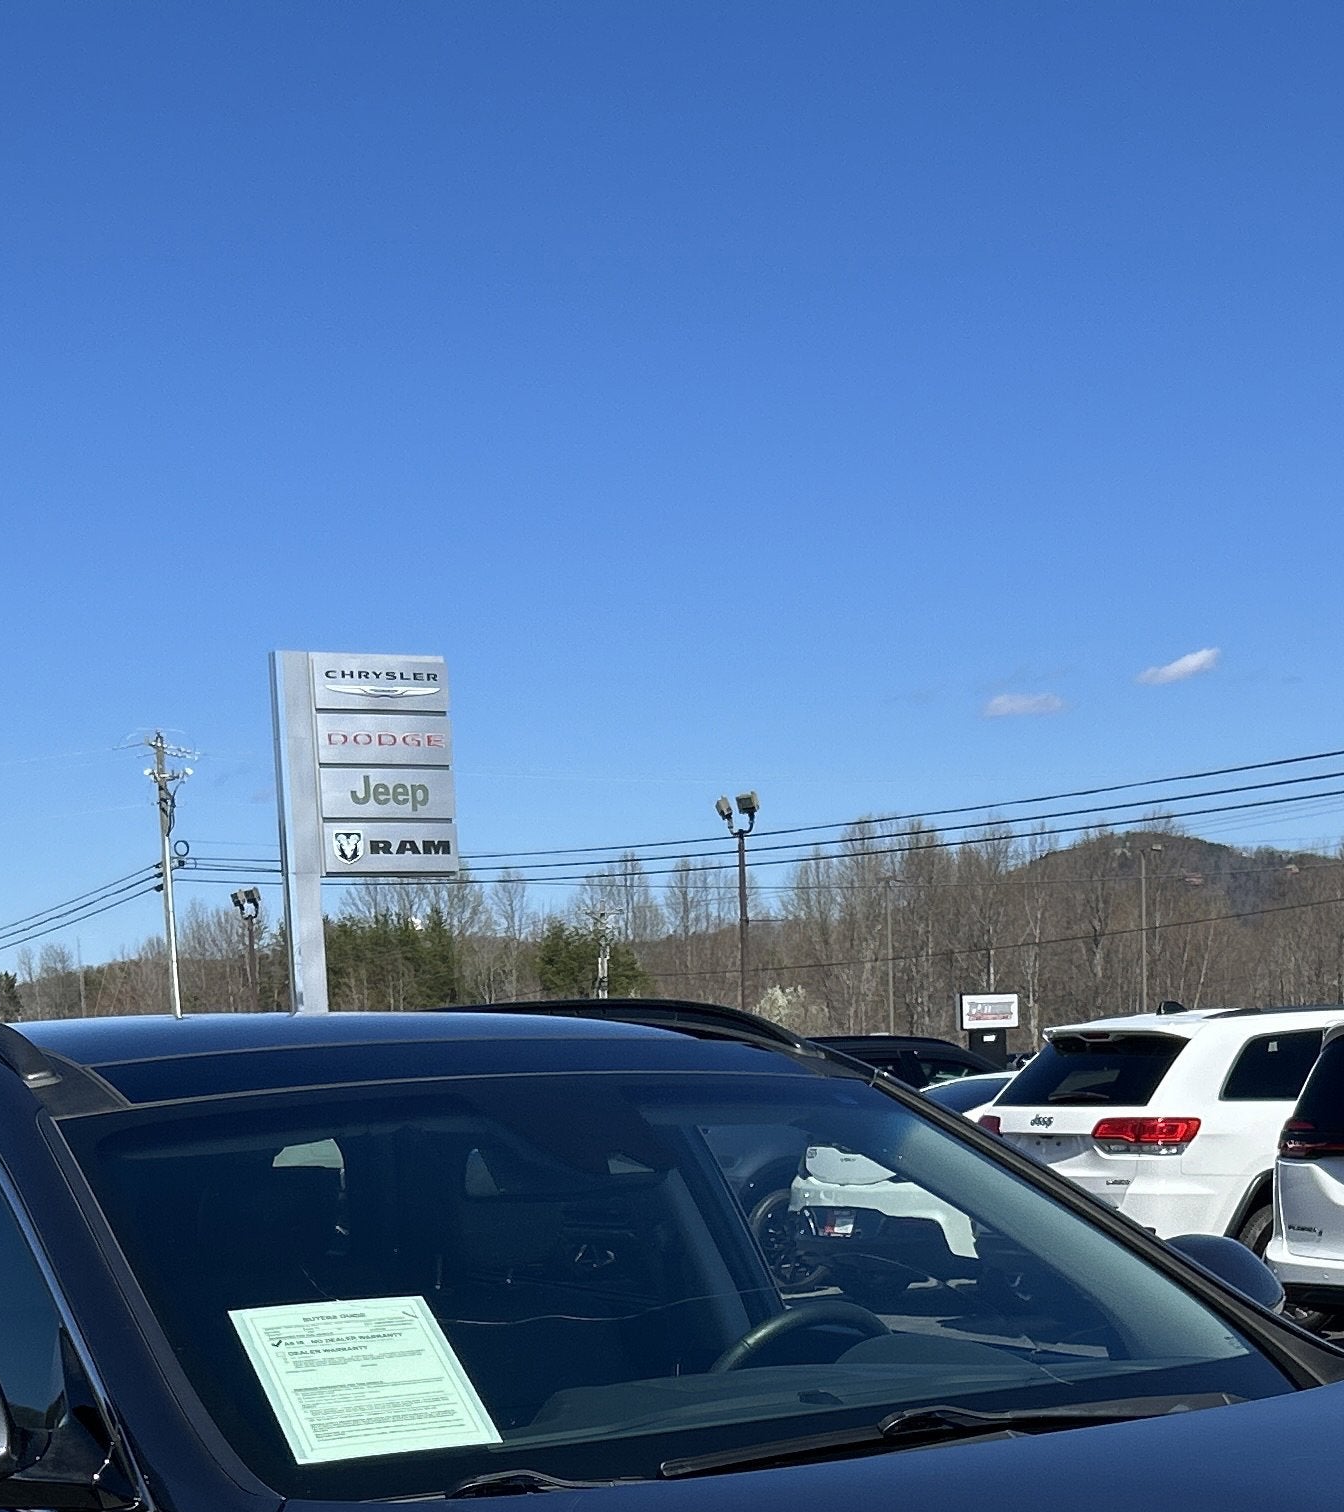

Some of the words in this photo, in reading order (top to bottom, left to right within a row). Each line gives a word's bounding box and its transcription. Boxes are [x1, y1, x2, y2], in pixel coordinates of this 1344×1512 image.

[325, 670, 438, 682] CHRYSLER
[327, 732, 445, 748] DODGE
[350, 775, 429, 811] Jeep
[369, 839, 451, 855] RAM
